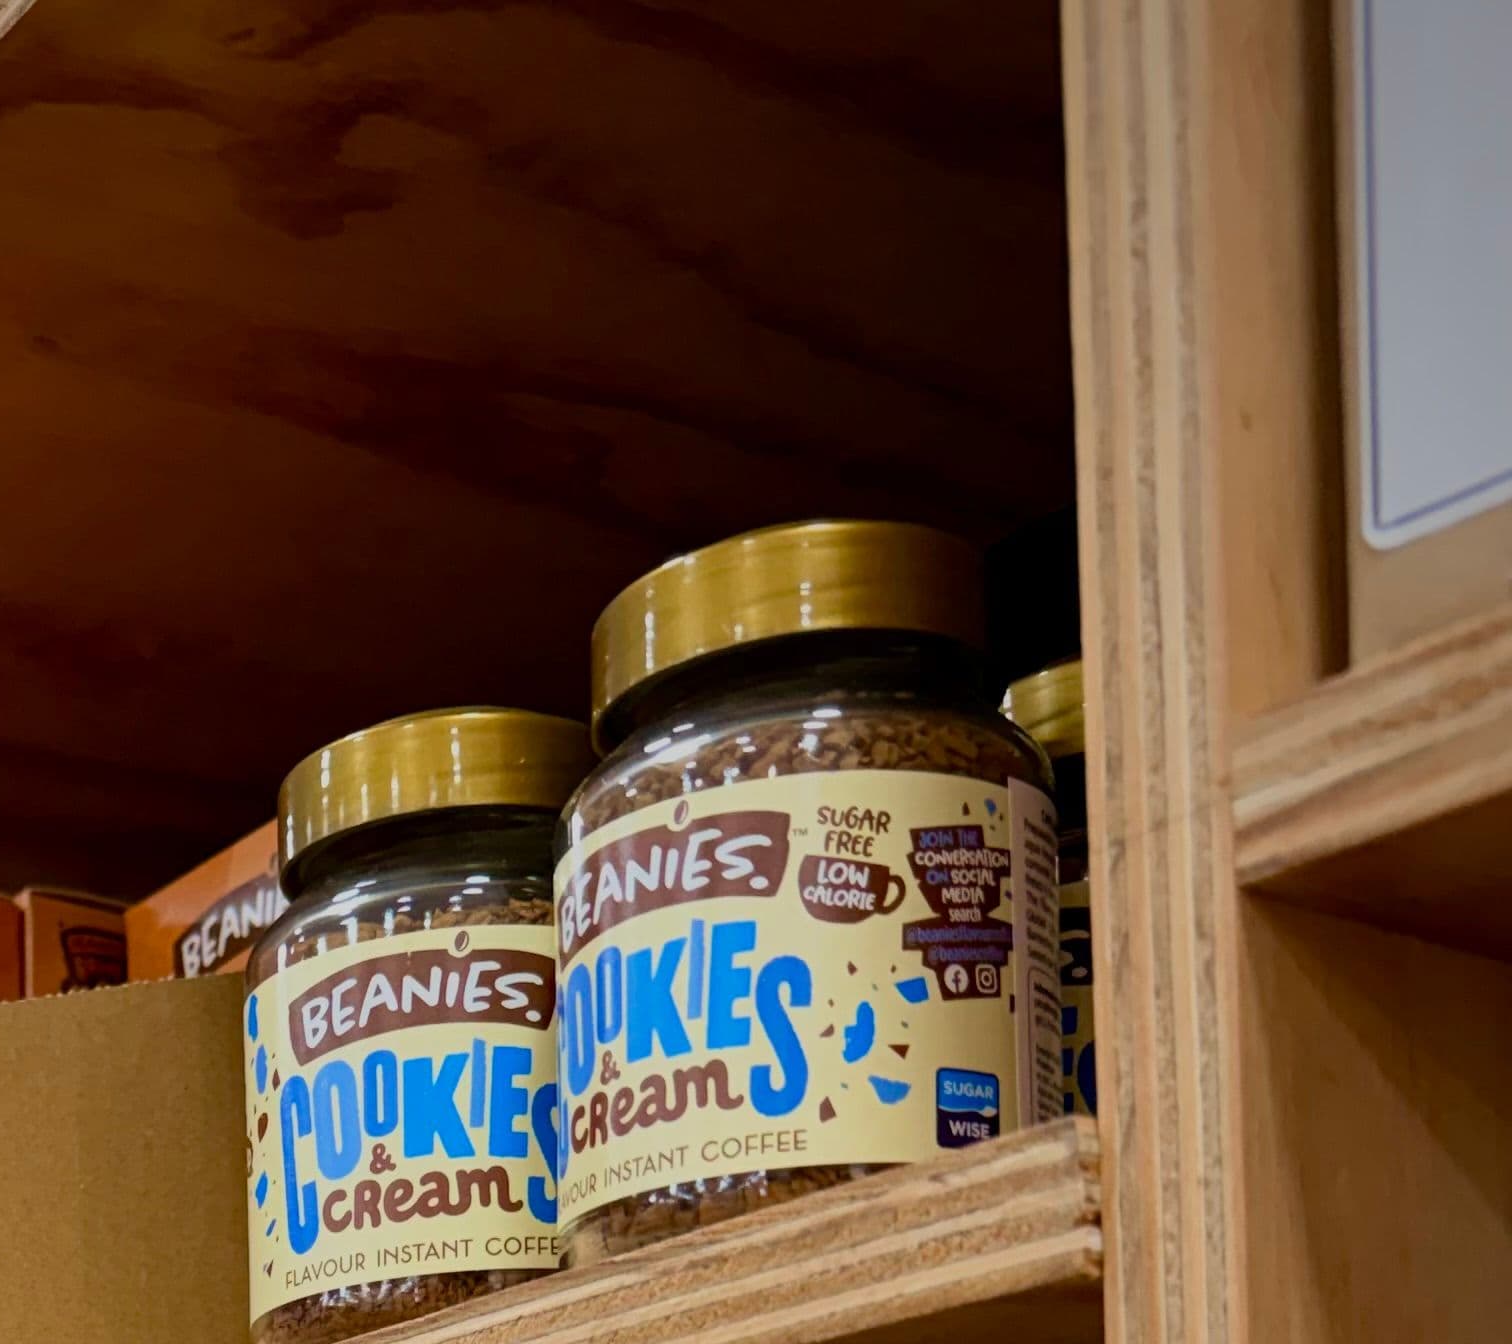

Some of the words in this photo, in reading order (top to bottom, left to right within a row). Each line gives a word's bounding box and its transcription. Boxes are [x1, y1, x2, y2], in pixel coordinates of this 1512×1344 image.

[817, 806, 891, 833] SUGAR
[824, 830, 875, 857] FREE
[919, 830, 953, 849] JOIN
[958, 830, 979, 847] THE
[914, 849, 1009, 867] CONVERSATION
[818, 860, 870, 886] LOW
[925, 869, 950, 886] ON
[950, 868, 996, 885] SOCIAL
[803, 885, 876, 911] CALORIE
[941, 887, 985, 904] MEDIA
[949, 907, 981, 923] search
[600, 1050, 621, 1086] &
[943, 1079, 994, 1101] SUGAR
[948, 1119, 990, 1139] WISE
[370, 1143, 396, 1174] &
[604, 1146, 689, 1188] INSTANT
[701, 1129, 809, 1163] COFFEE
[286, 1253, 365, 1289] FLAVOUR
[377, 1239, 473, 1268] INSTANT
[485, 1236, 558, 1257] COFFE
